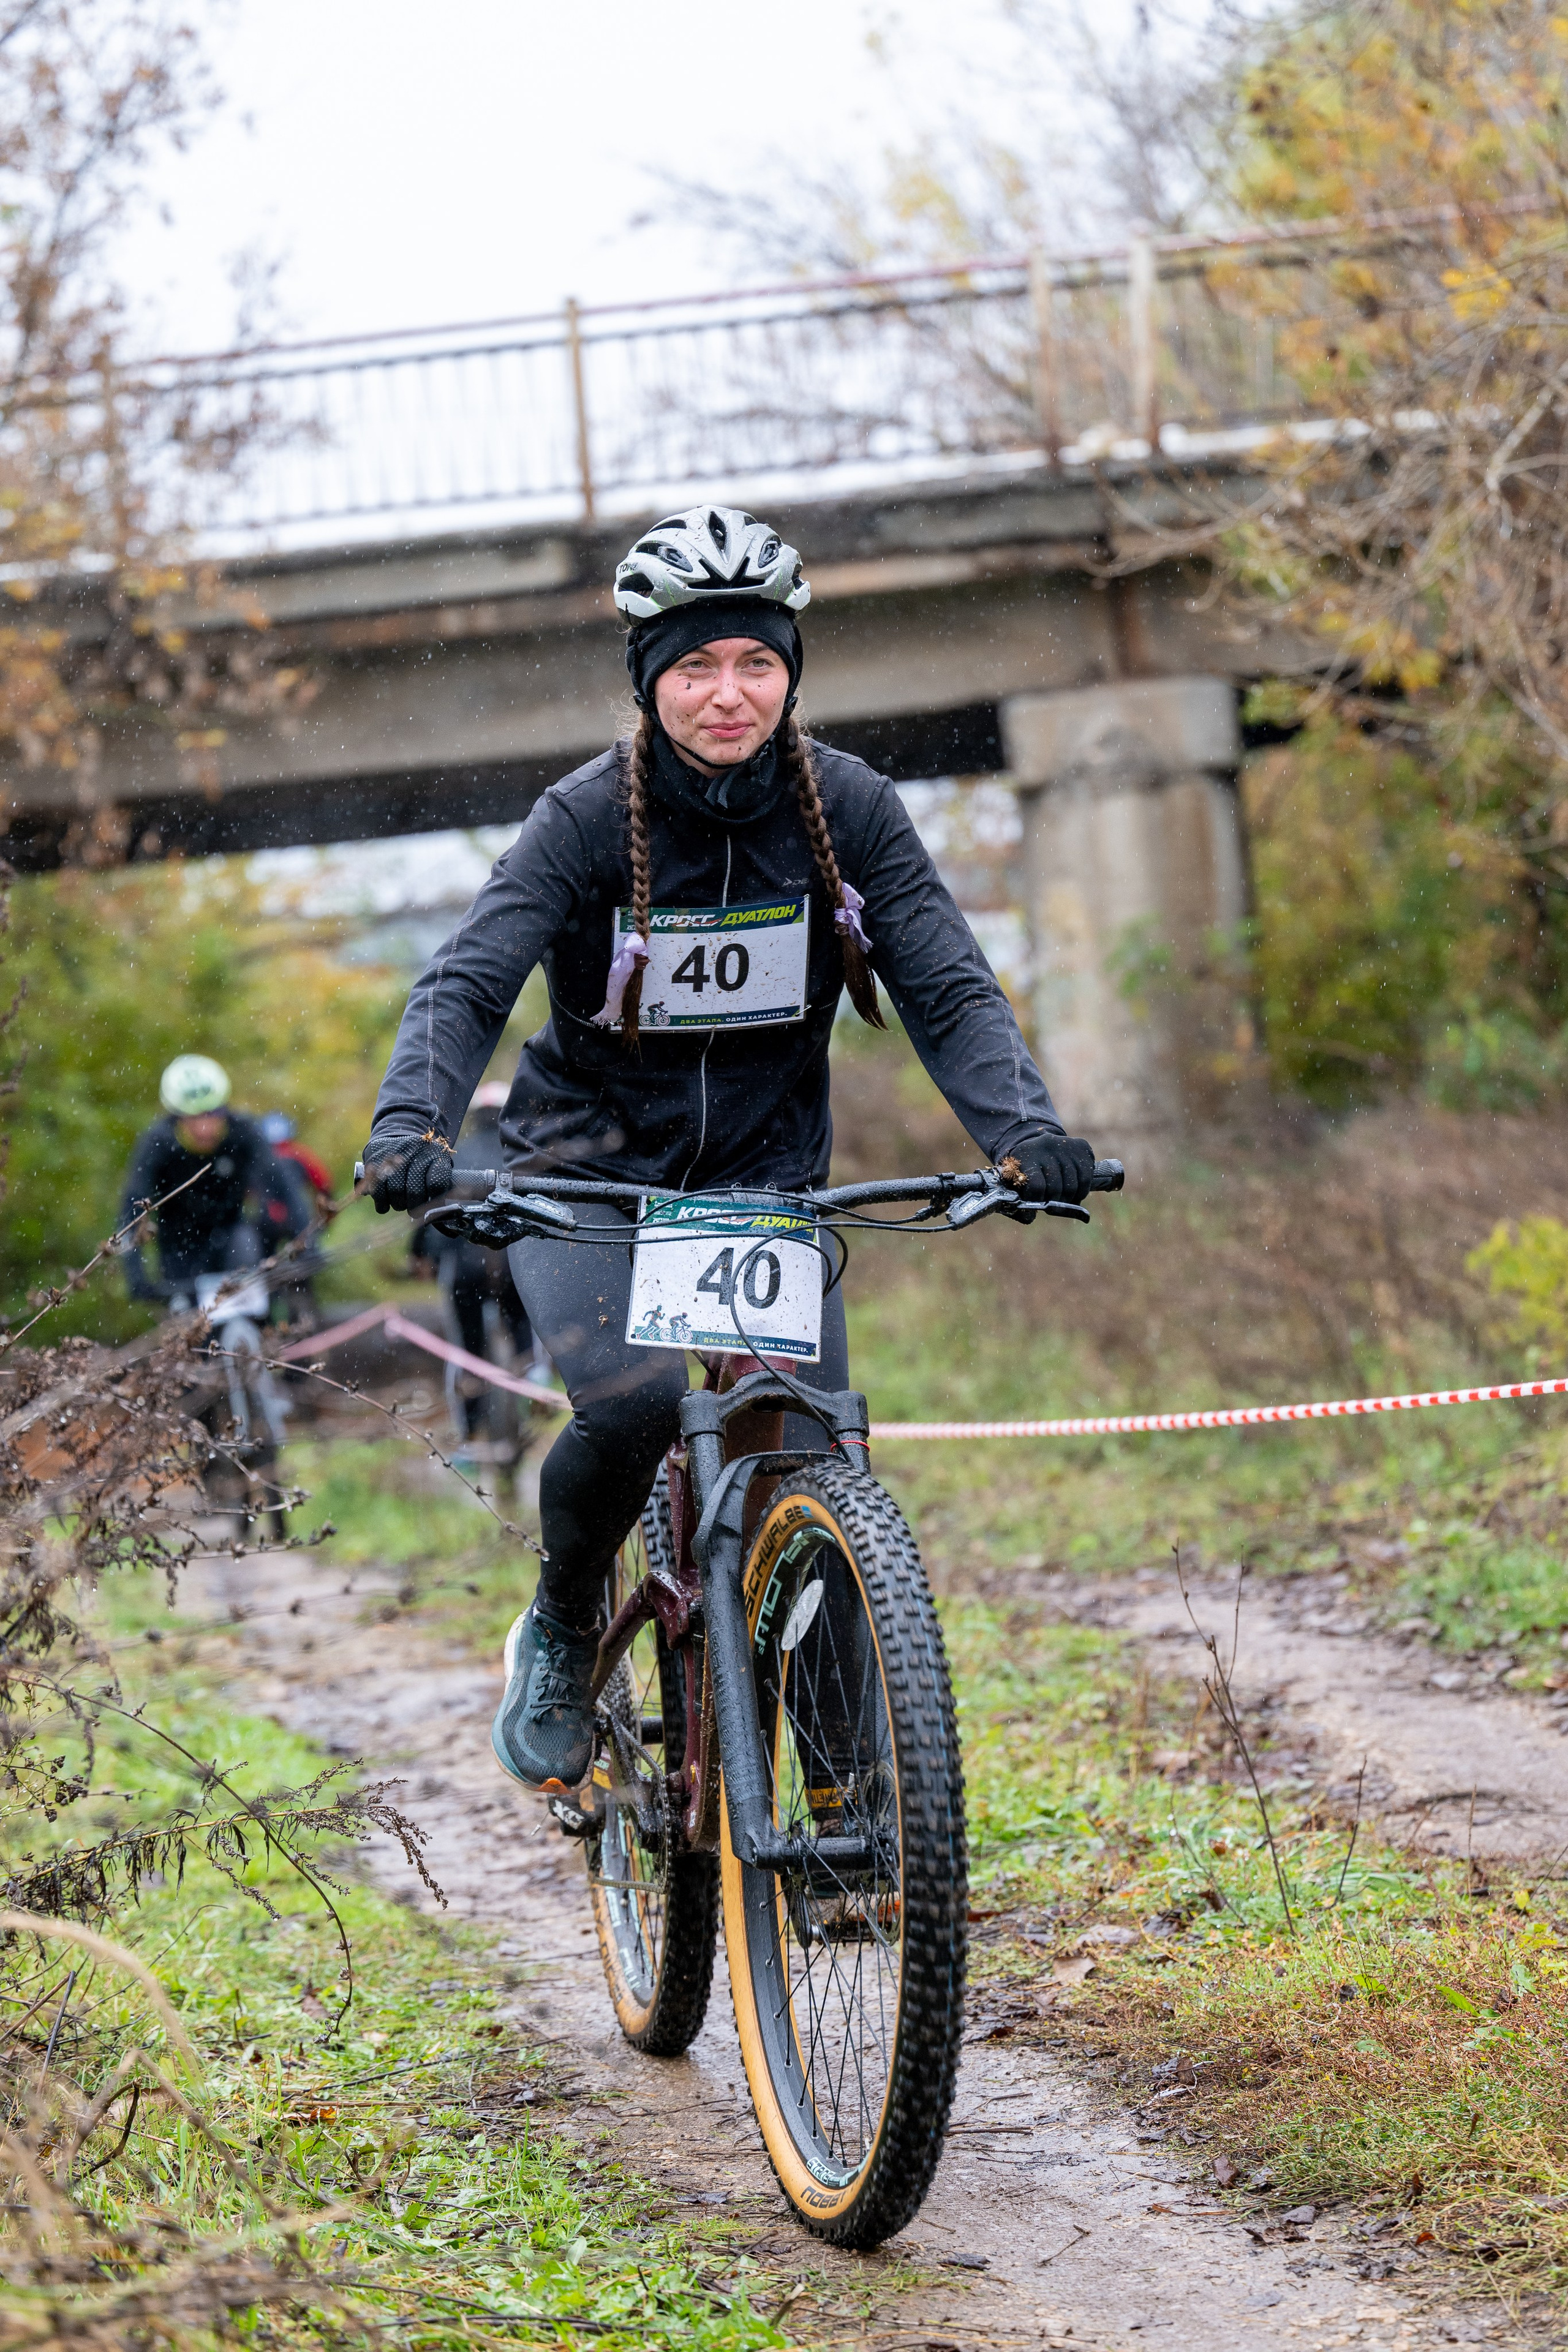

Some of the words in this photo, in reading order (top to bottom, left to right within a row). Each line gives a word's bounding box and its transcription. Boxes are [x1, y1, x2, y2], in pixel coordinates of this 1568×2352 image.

[649, 914, 716, 927] КРОСС
[720, 905, 796, 927] ДУАТЛОН
[671, 943, 749, 992] 40
[696, 1247, 781, 1309] 40
[777, 1343, 809, 1353] ХАРАКТЕР.
[745, 1506, 805, 1618] SCHWALBE
